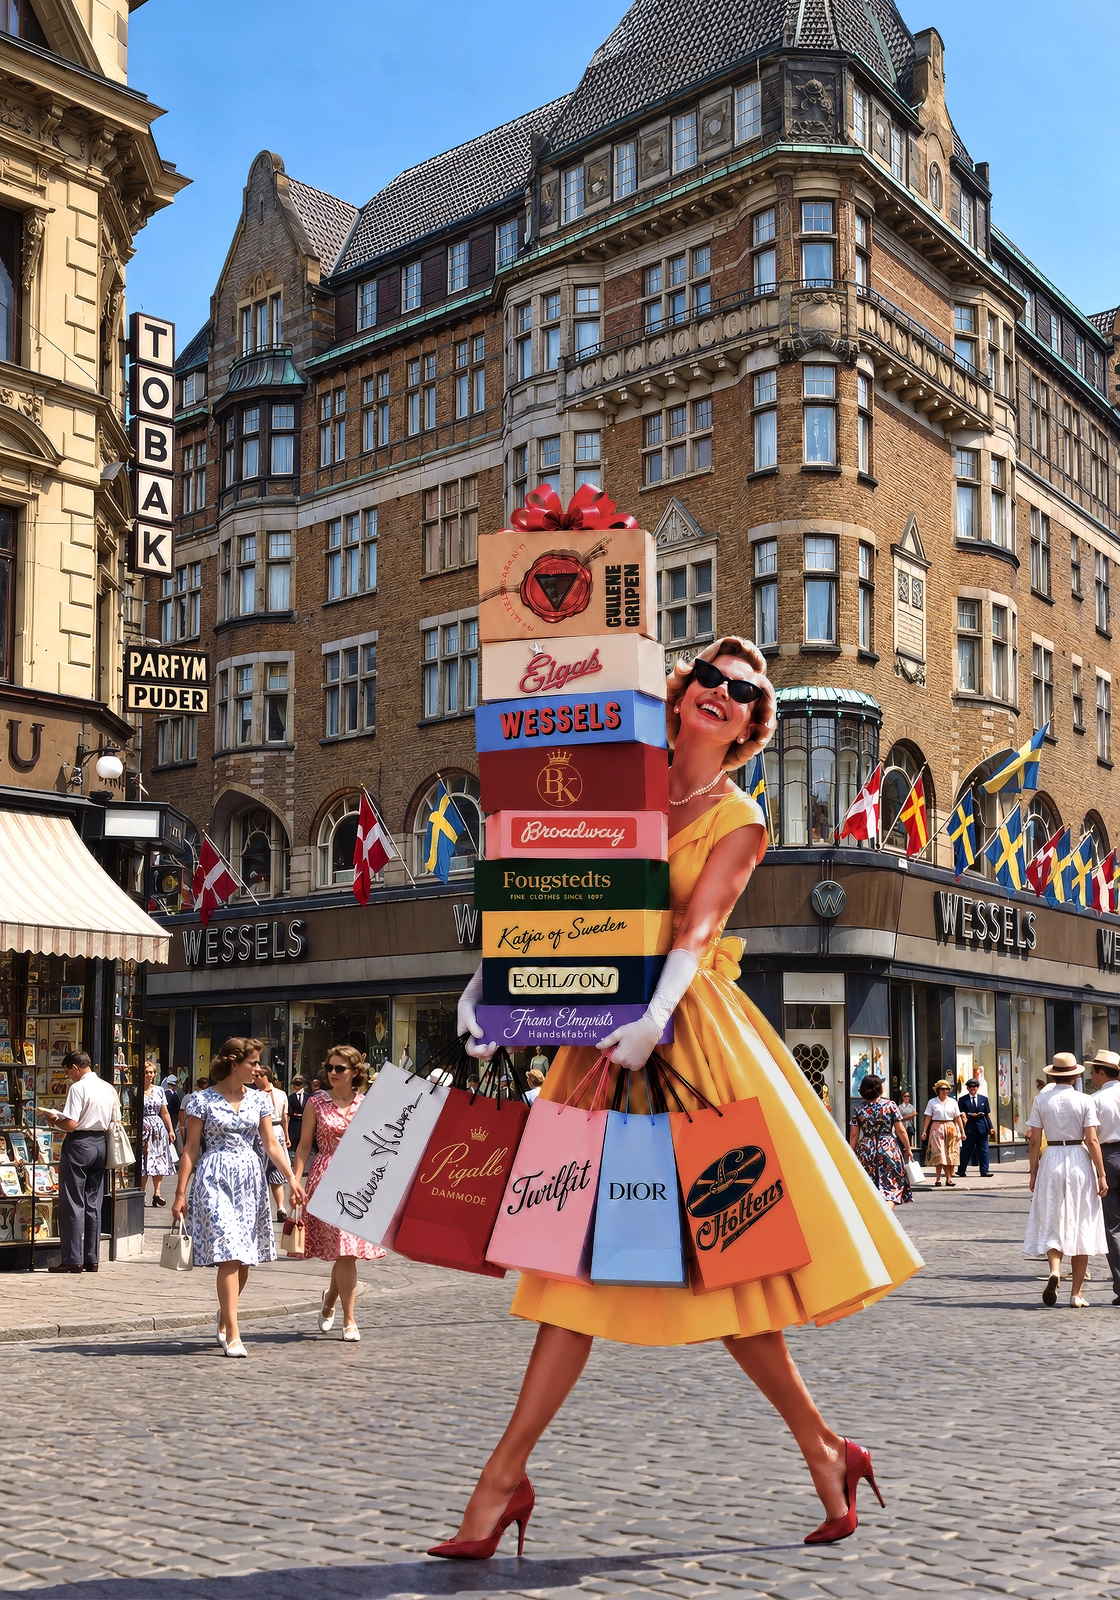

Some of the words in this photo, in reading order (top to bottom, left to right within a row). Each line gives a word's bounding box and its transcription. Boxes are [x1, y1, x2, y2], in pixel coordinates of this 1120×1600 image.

[142, 322, 170, 567] TOBAK
[624, 563, 640, 627] GRIPEN
[129, 651, 206, 681] PARFYM
[134, 686, 204, 710] PUDER
[500, 701, 621, 740] WESSELS
[8, 718, 46, 767] U
[520, 820, 626, 848] Broadway
[502, 870, 612, 893] Fougstedts
[529, 893, 561, 901] CLOTHES
[497, 925, 545, 954] Katja
[547, 928, 565, 949] of
[567, 916, 627, 940] Sweden
[934, 890, 1038, 950] WESSELS
[182, 919, 307, 966] WESSELS
[503, 1008, 552, 1039] Frans
[555, 1007, 614, 1031] Elmqvists
[528, 1030, 598, 1039] Handskfabrik
[420, 1142, 508, 1188] Pigalle
[431, 1187, 487, 1206] DAMMODE
[506, 1159, 592, 1215] Twilfit
[609, 1182, 668, 1201] DIOR
